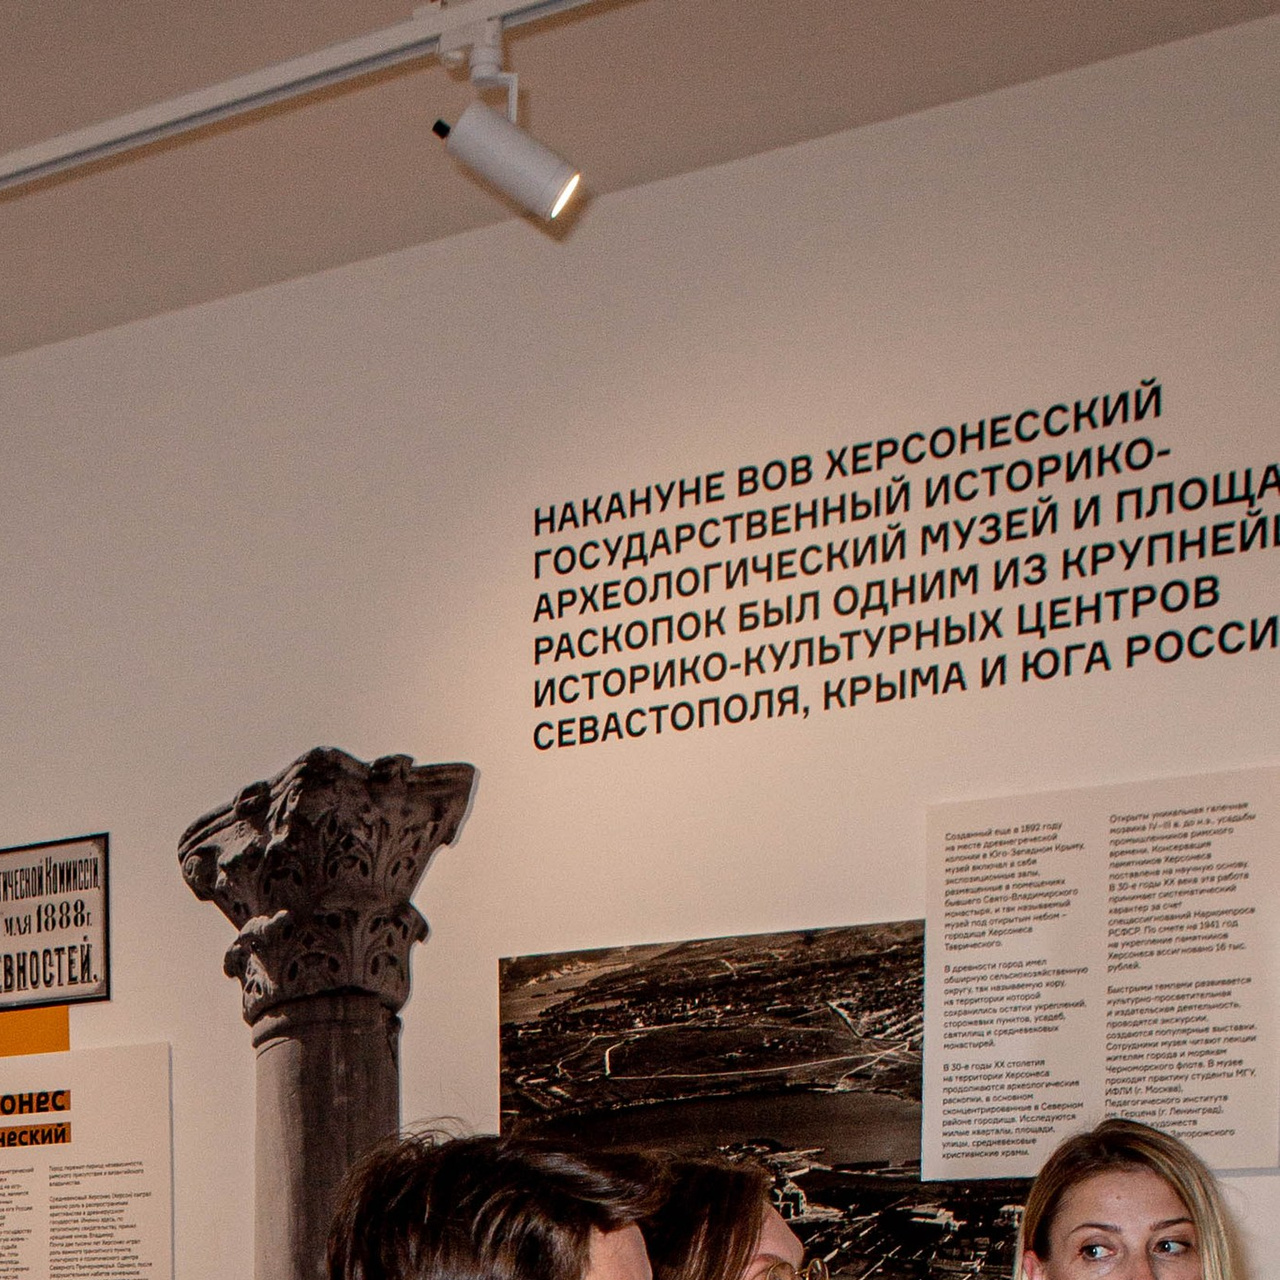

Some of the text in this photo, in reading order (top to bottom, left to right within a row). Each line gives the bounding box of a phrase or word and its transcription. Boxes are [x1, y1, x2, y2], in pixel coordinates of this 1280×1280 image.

[535, 378, 1161, 536] НАКАНУНЕ ВОВ ХЕРСОНЕССКИЙ
[535, 438, 1170, 579] ГОСУДАРСТВЕННЫЙ ИСТОРИКО-
[534, 464, 1280, 622] АРХЕОЛОГИЧЕСКИЙ МУЗЕЙ И ПЛОЩА
[535, 509, 1280, 664] РАСКОПОК БЫЛ ОДНИМ ИЗ КРУПНЕЙ
[534, 616, 1277, 750] СЕВАСТОПОЛЯ, КРЫМА И ЮГА РОССИ
[535, 576, 1219, 707] ИСТОРИКО-КУЛЬТУРНЫХ ЦЕНТРОВ
